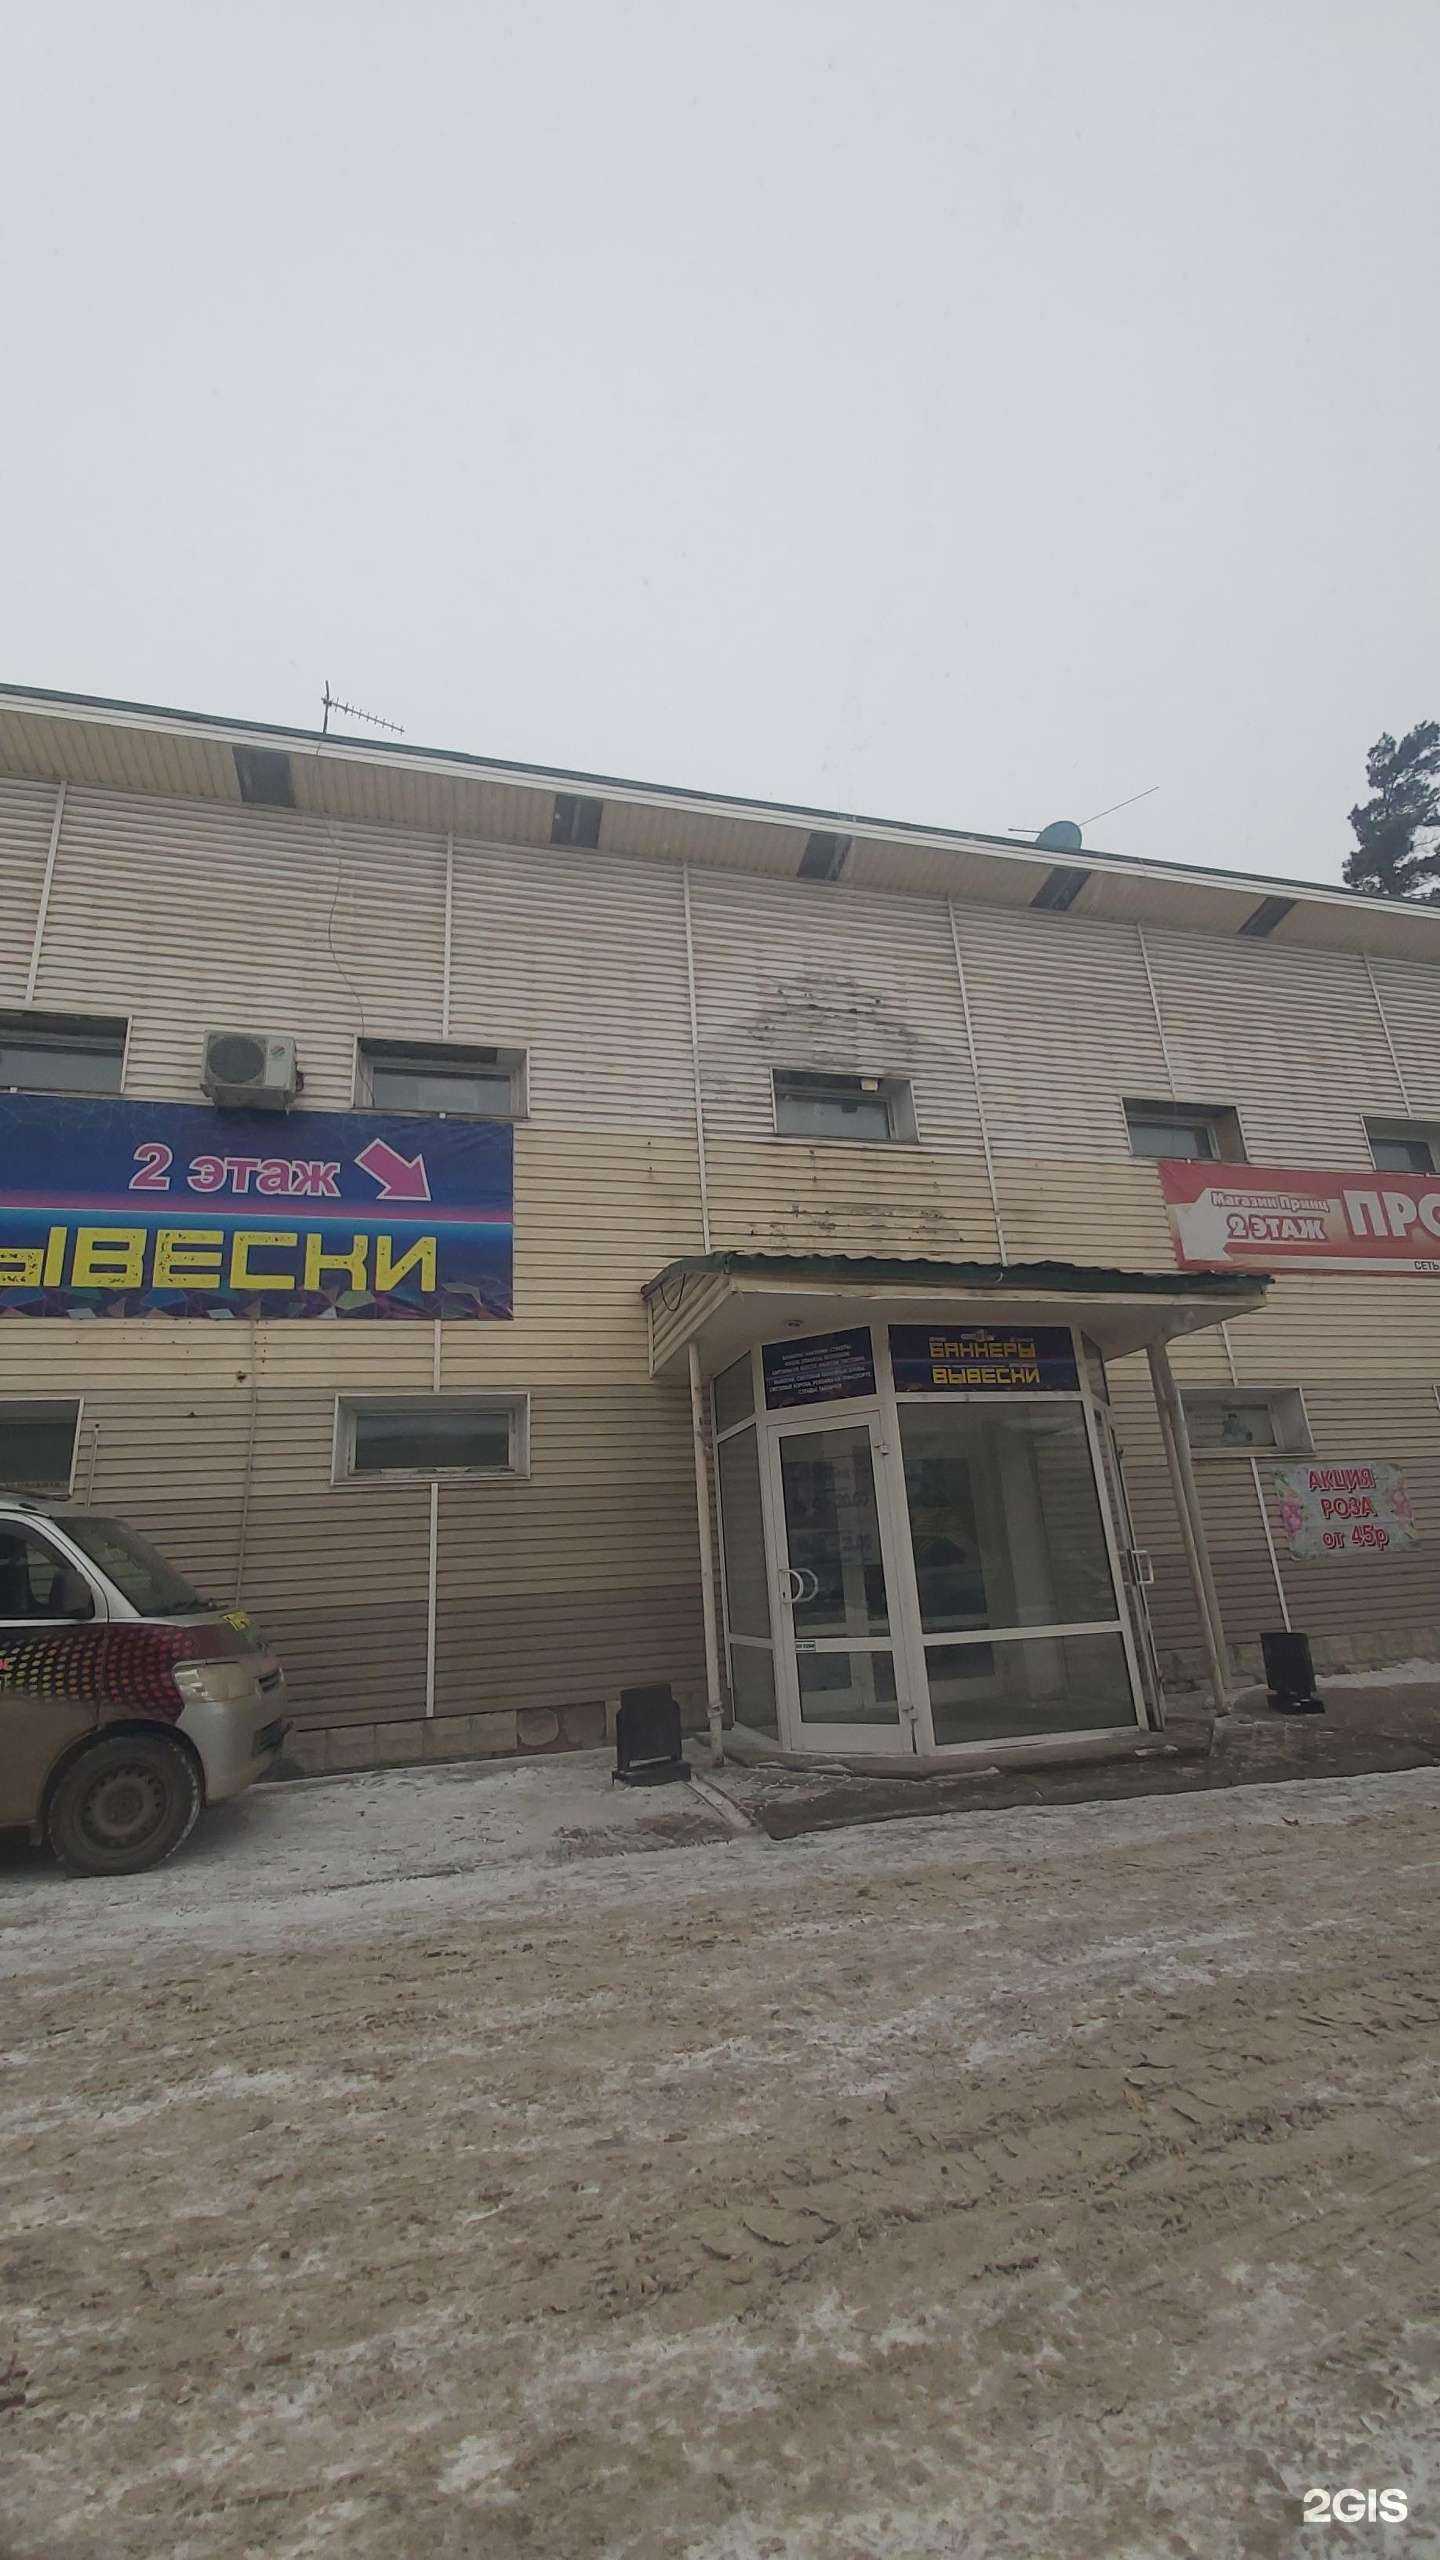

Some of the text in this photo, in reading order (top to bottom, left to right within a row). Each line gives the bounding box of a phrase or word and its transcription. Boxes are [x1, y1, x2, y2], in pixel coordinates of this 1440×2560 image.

[129, 1142, 341, 1197] 2 этаж
[1211, 1192, 1330, 1212] Магазин Принц
[1227, 1213, 1328, 1240] 2 ЭТАЖ
[1414, 1261, 1440, 1271] СЕТЬ
[929, 1342, 1036, 1358] БАННЕРЫ
[932, 1368, 1040, 1384] ВЫВЕСКИ
[1309, 1468, 1376, 1492] АКЦИЯ
[1321, 1496, 1377, 1519] РОЗА
